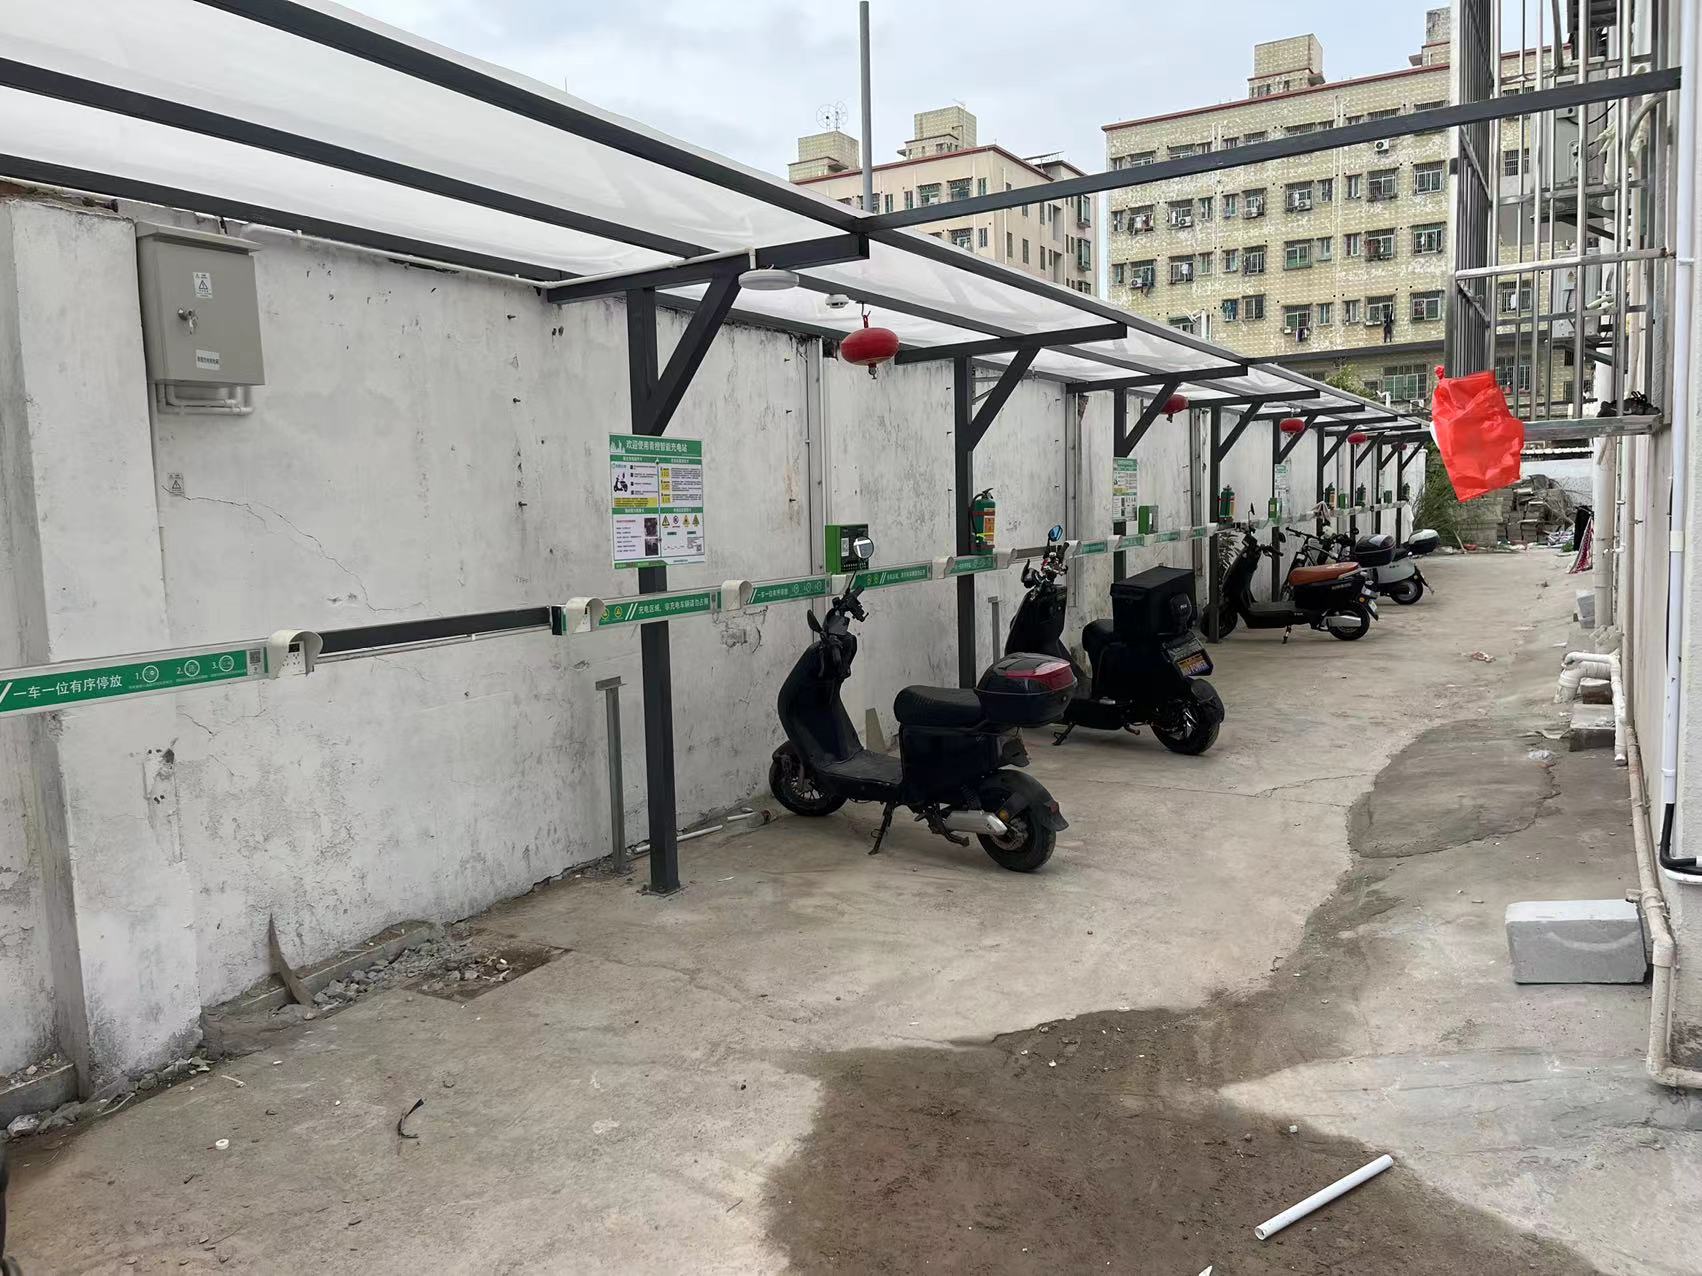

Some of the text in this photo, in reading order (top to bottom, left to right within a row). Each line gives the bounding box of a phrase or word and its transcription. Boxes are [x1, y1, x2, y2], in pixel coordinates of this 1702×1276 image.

[13, 674, 123, 699] 一车一位有序停放
